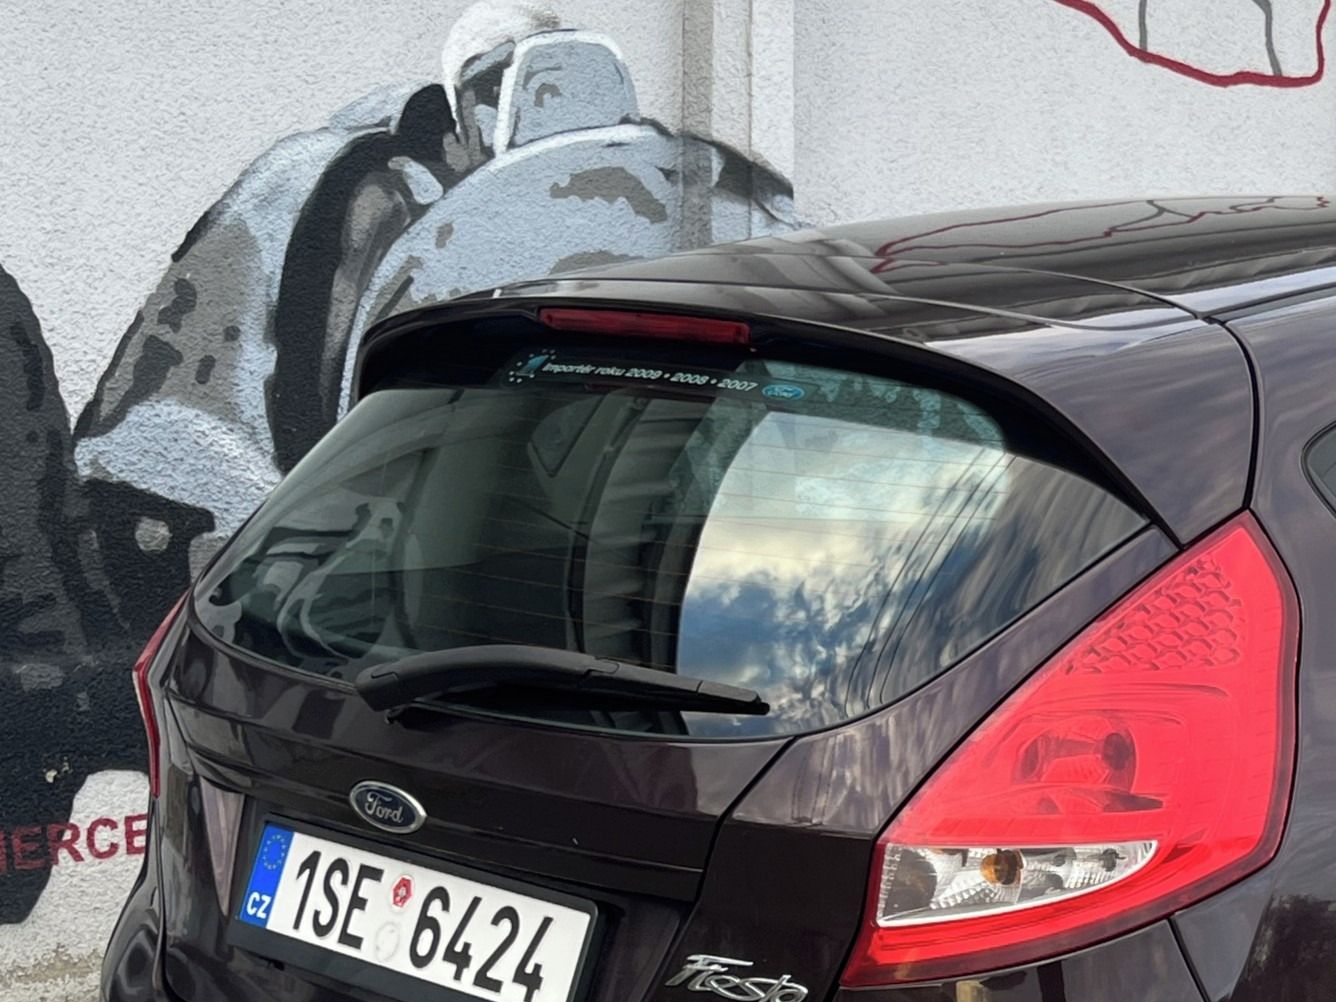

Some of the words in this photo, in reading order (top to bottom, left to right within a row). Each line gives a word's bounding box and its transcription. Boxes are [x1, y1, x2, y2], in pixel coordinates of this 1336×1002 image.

[624, 367, 663, 379] 2009
[669, 372, 710, 385] 2008
[716, 378, 758, 391] 2007
[364, 791, 404, 823] Ford
[246, 891, 271, 919] CZ
[293, 850, 384, 950] 1SE
[409, 886, 554, 1002] 6424
